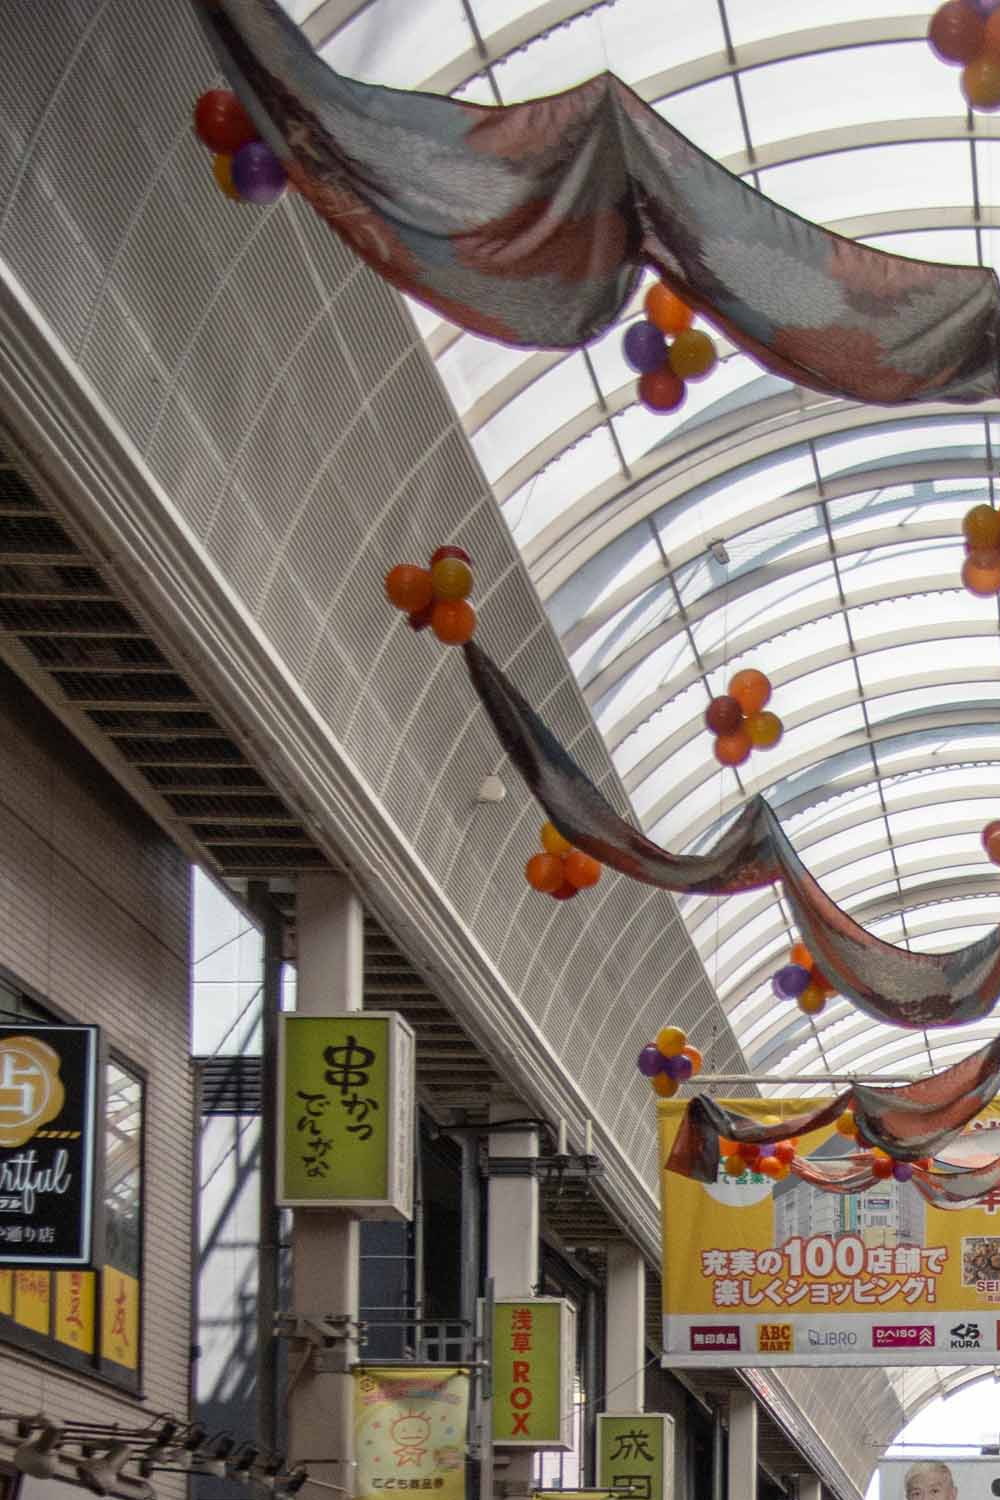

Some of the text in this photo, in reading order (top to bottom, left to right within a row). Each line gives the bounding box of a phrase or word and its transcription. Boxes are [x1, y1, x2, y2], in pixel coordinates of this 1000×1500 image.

[323, 1034, 379, 1142] 串かつ
[296, 1090, 334, 1180] でんがな
[701, 1234, 948, 1278] 充実の100店舗で
[759, 1325, 791, 1340] ABC
[818, 1331, 857, 1346] LIBRO
[876, 1328, 916, 1339] DAISO
[951, 1323, 980, 1339] くら
[693, 1332, 738, 1346] 無印良品
[759, 1341, 791, 1352] MART
[951, 1339, 980, 1349] KURA
